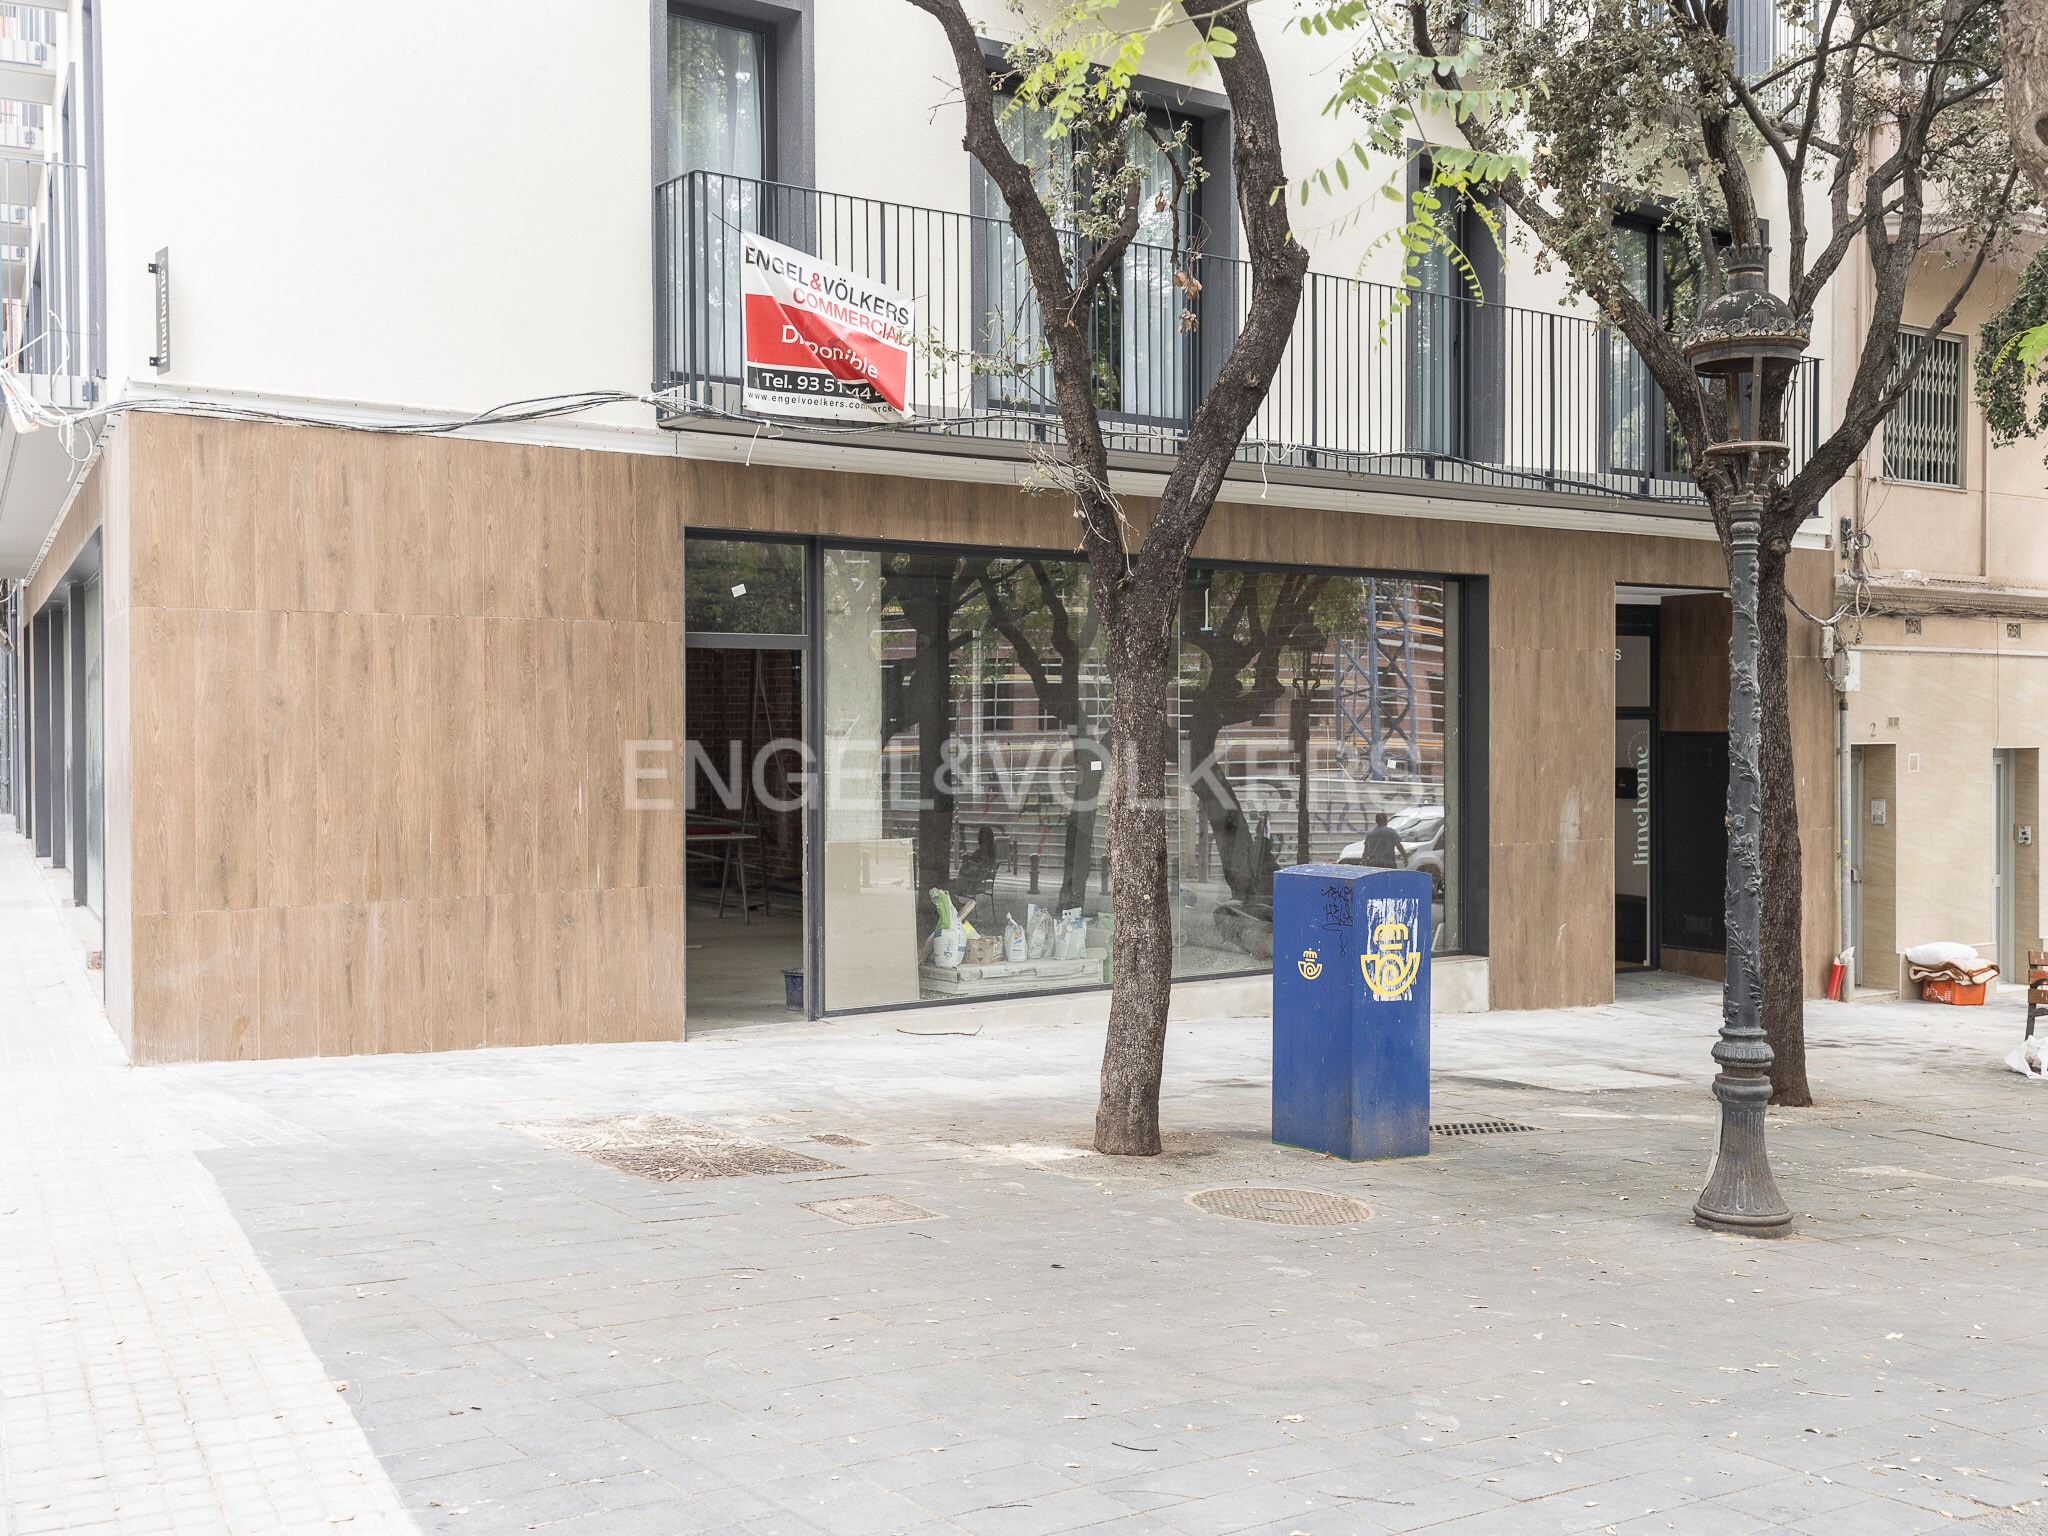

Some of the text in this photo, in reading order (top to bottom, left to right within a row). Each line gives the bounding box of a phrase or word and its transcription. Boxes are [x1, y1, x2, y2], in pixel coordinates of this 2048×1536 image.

[745, 245, 909, 325] ENGEL&VÖLKERS
[792, 287, 911, 347] COMMERCIAL
[781, 325, 878, 379] Diponible
[761, 372, 792, 389] Tel.
[797, 375, 820, 391] 93
[1870, 722, 1876, 737] 2
[1632, 745, 1650, 866] limehome
